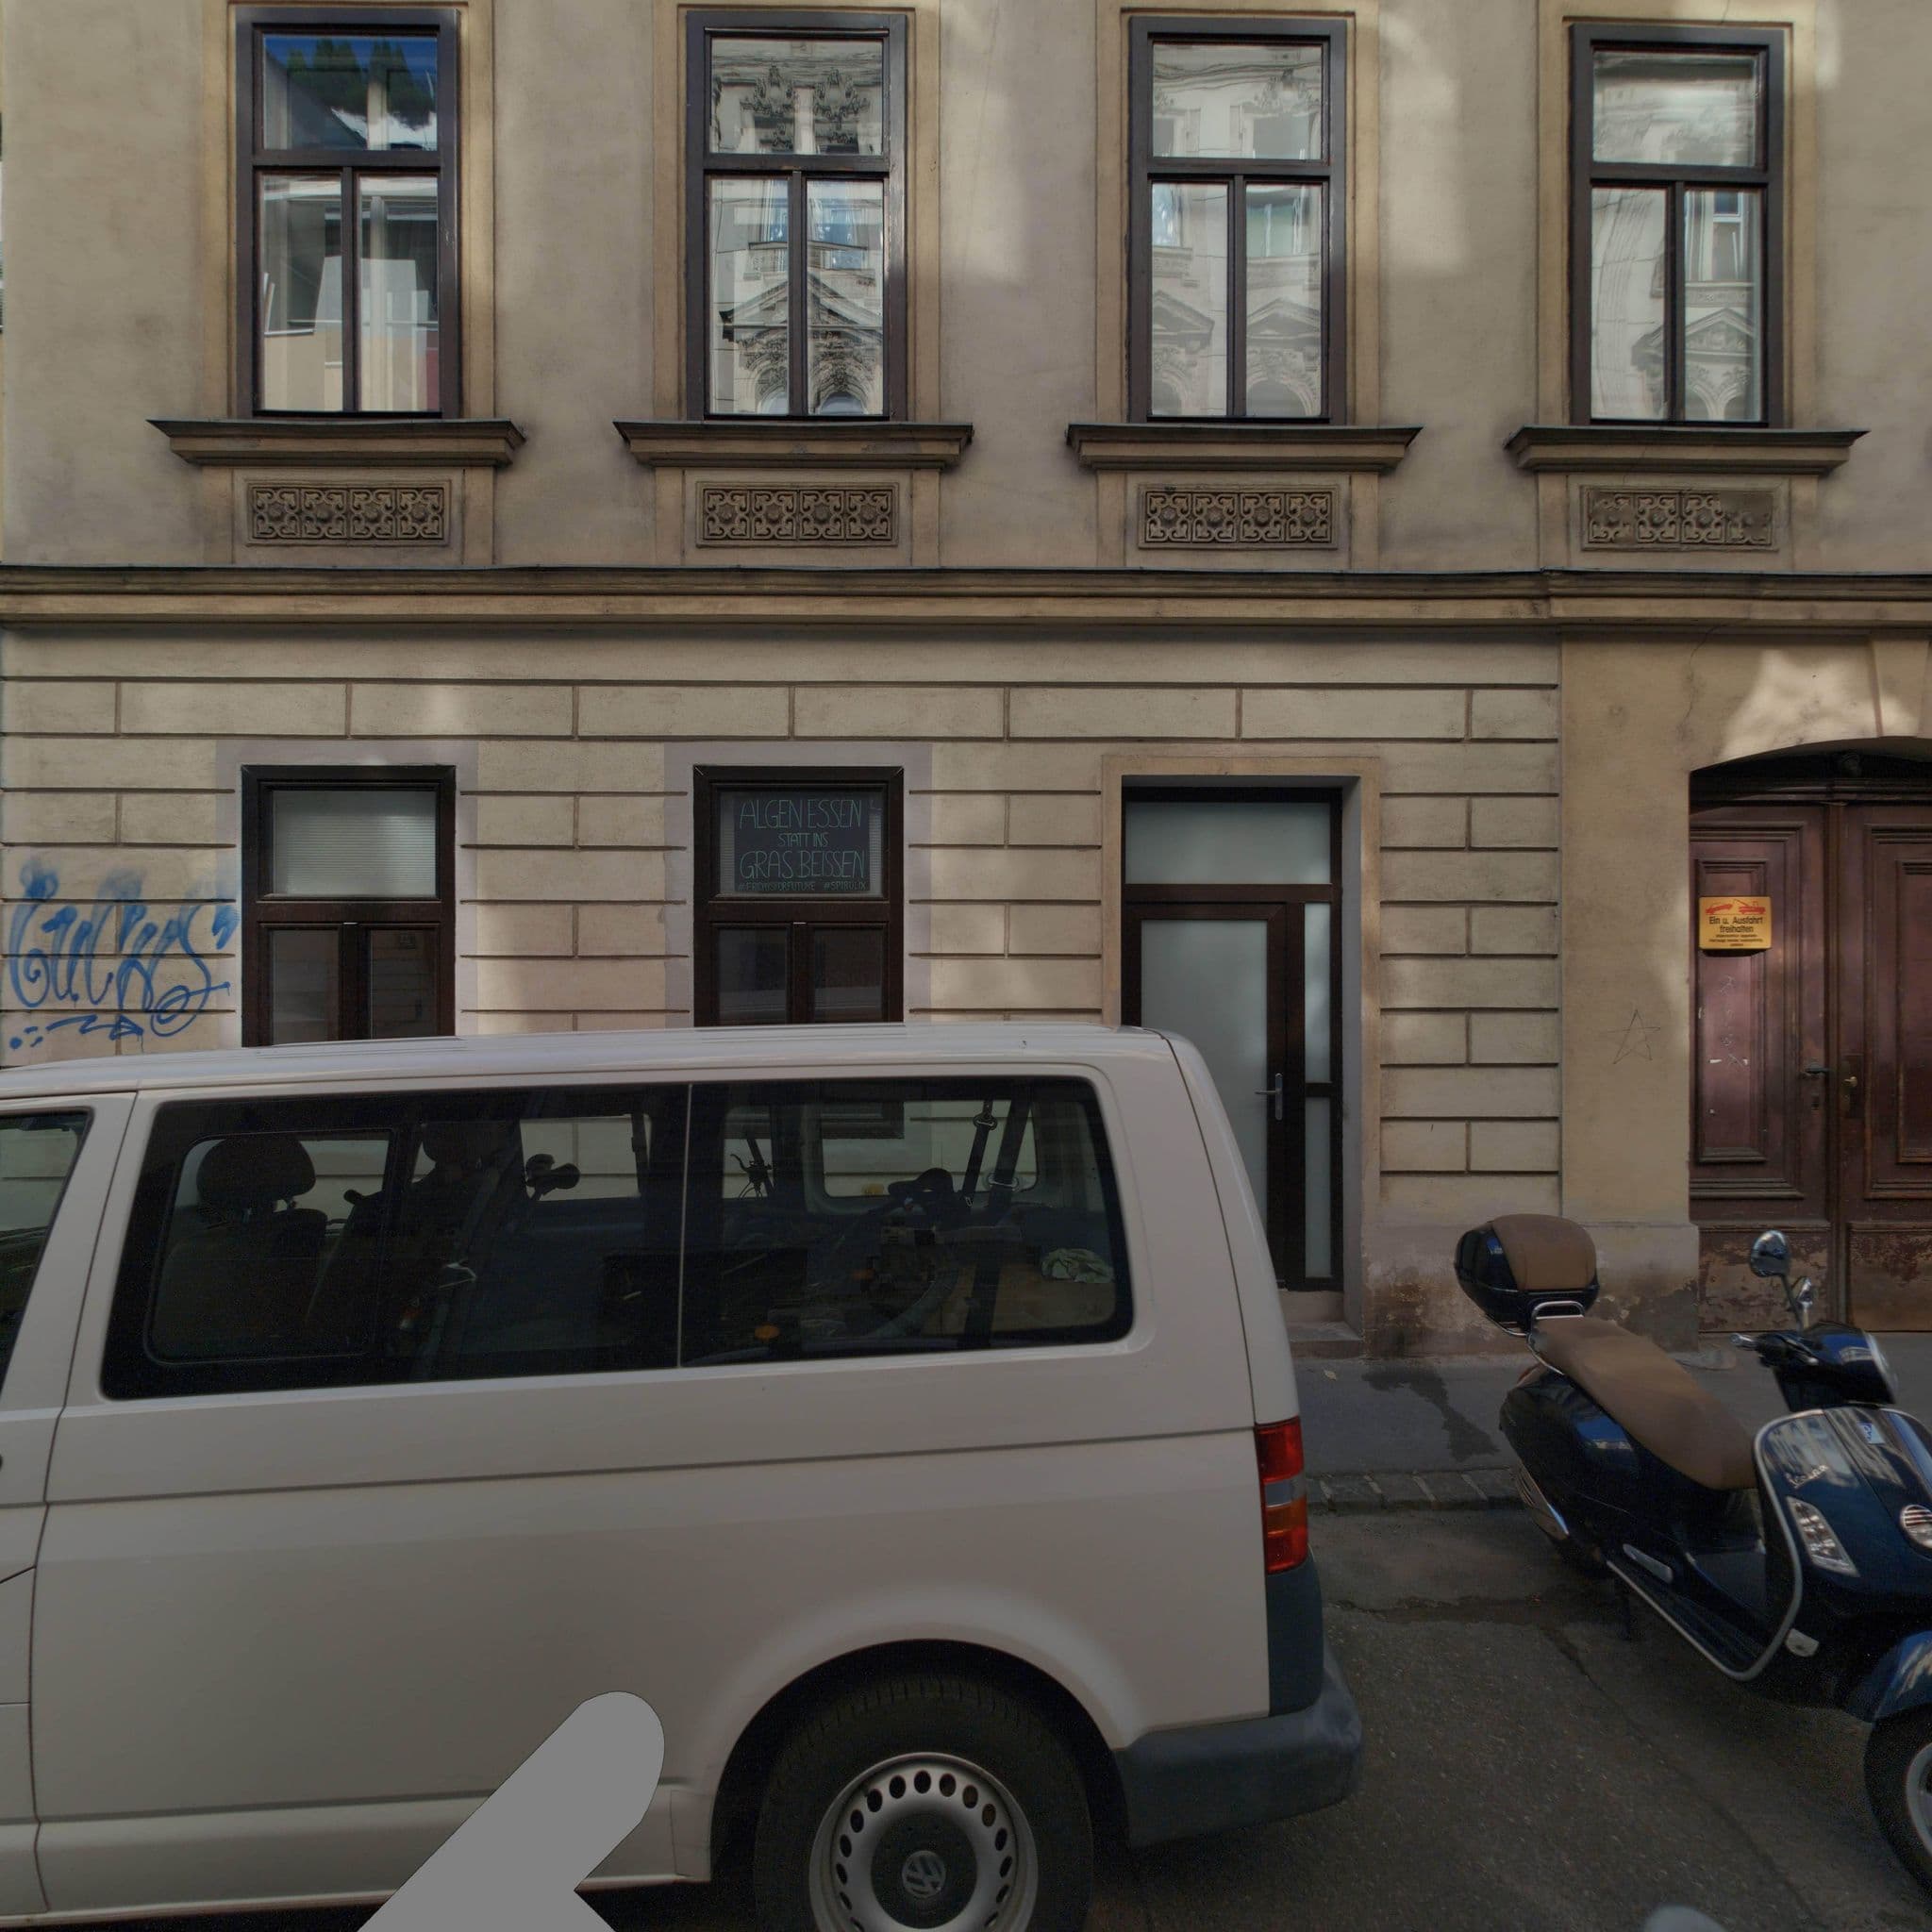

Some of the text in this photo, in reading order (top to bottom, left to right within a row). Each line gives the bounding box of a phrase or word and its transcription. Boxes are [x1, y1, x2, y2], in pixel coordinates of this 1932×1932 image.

[739, 799, 860, 829] ALGEN ESSEN
[778, 832, 829, 847] STATT INS
[740, 850, 865, 879] GRAS BEISSEN
[1708, 916, 1720, 924] Ein
[1733, 916, 1762, 924] Ausfahrt
